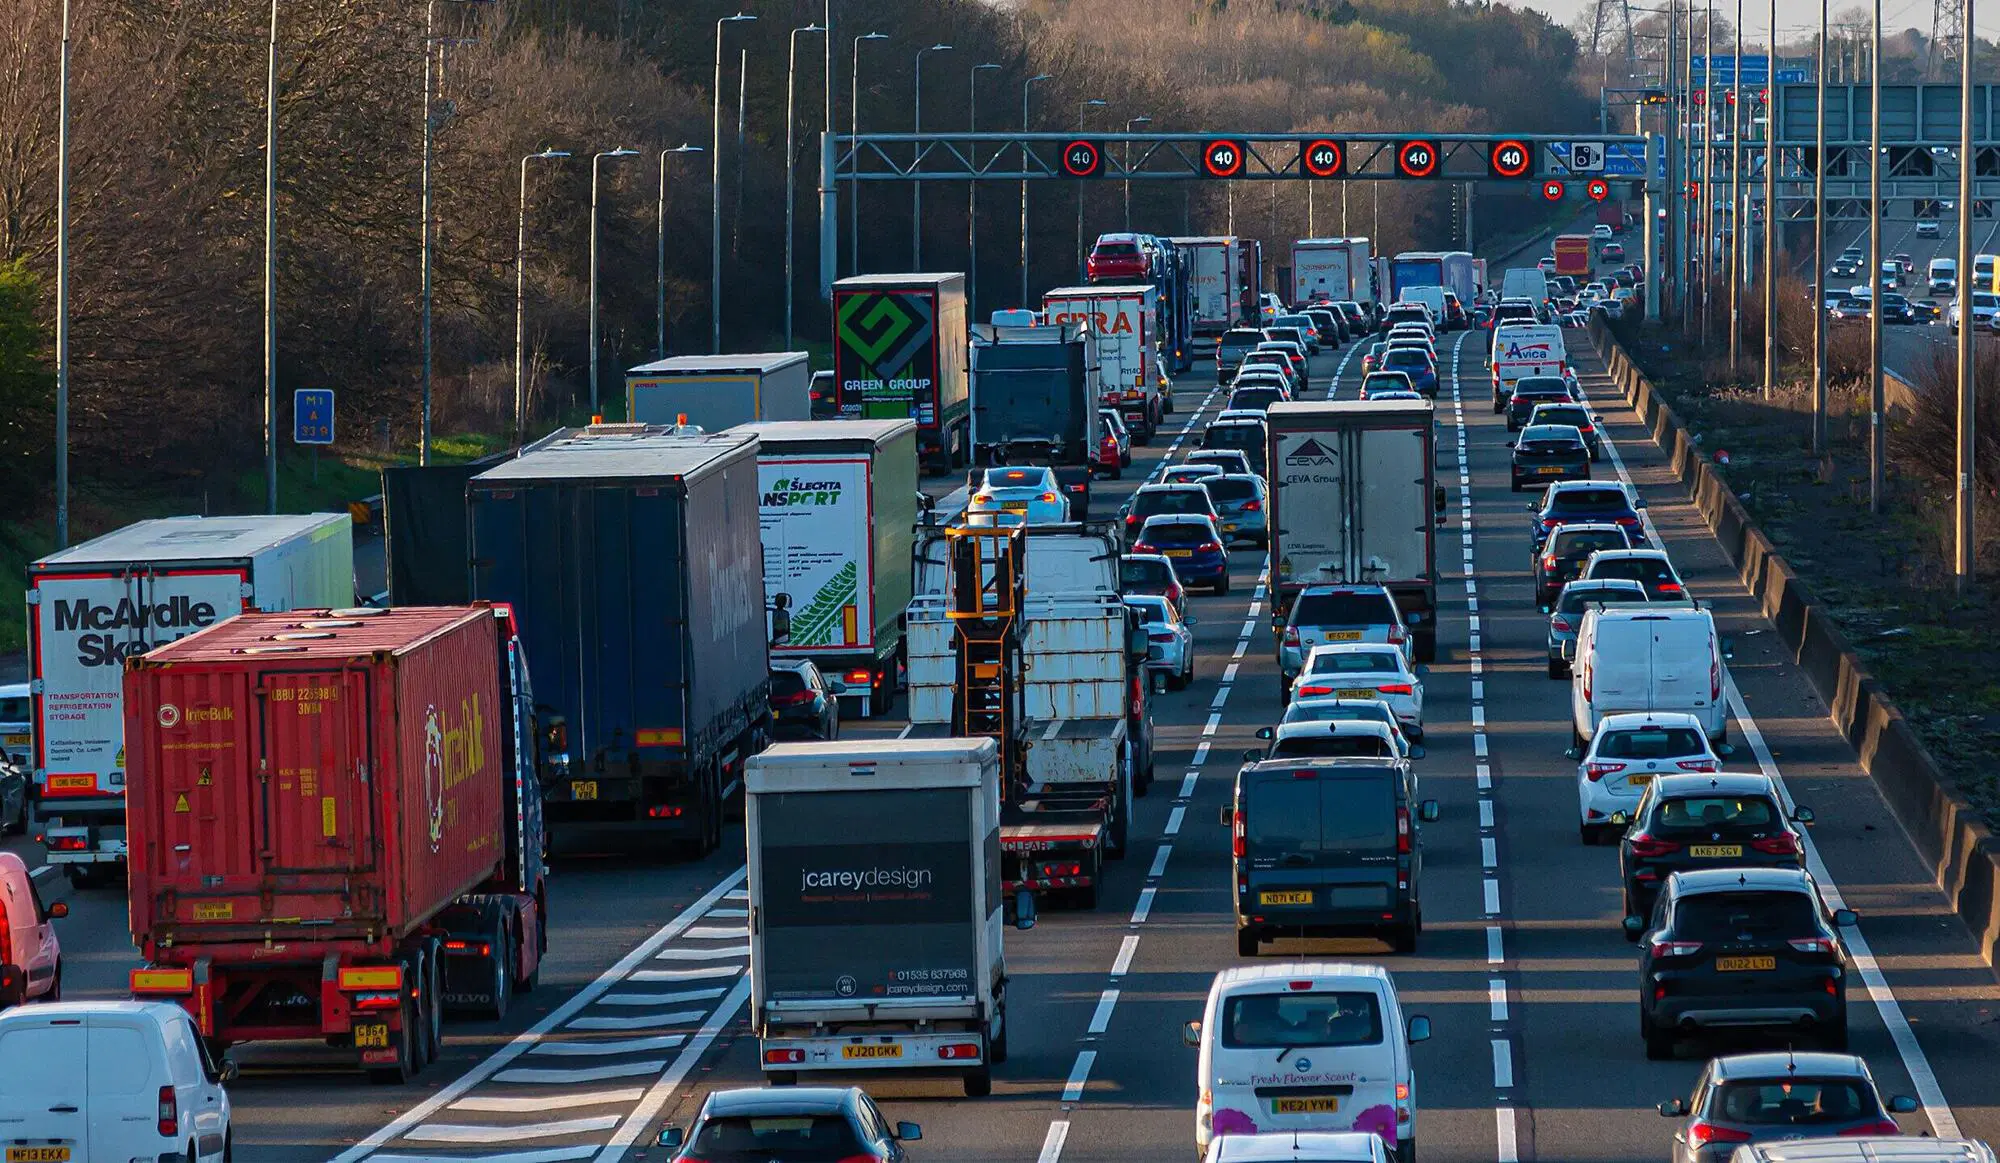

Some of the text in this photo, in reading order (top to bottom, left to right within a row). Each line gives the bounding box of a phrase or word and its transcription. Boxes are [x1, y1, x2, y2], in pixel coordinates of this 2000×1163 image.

[1072, 152, 1090, 164] 40
[1214, 151, 1233, 165] 40
[1314, 151, 1333, 165] 40
[1409, 152, 1428, 165] 40
[1501, 151, 1521, 165] 40
[1593, 186, 1603, 194] 50
[1506, 342, 1547, 359] Avica
[844, 378, 931, 391] GREEN GROUP
[310, 411, 318, 421] A
[790, 477, 841, 491] ŠLECHTA
[1287, 475, 1310, 483] CEVA
[54, 595, 216, 631] McArdle
[49, 692, 120, 700] TRANSPORTATION
[49, 703, 112, 711] REFRIGERATION
[801, 865, 932, 892] jcareydesign
[898, 970, 929, 980] 01535
[931, 969, 967, 979] 637968
[886, 983, 968, 995] jcareydesign.com
[847, 1046, 875, 1057] YJ20
[1251, 1072, 1356, 1085] Fresh Flower Scent
[1280, 1100, 1308, 1112] KE21
[13, 1149, 63, 1160] MF13 EKX
